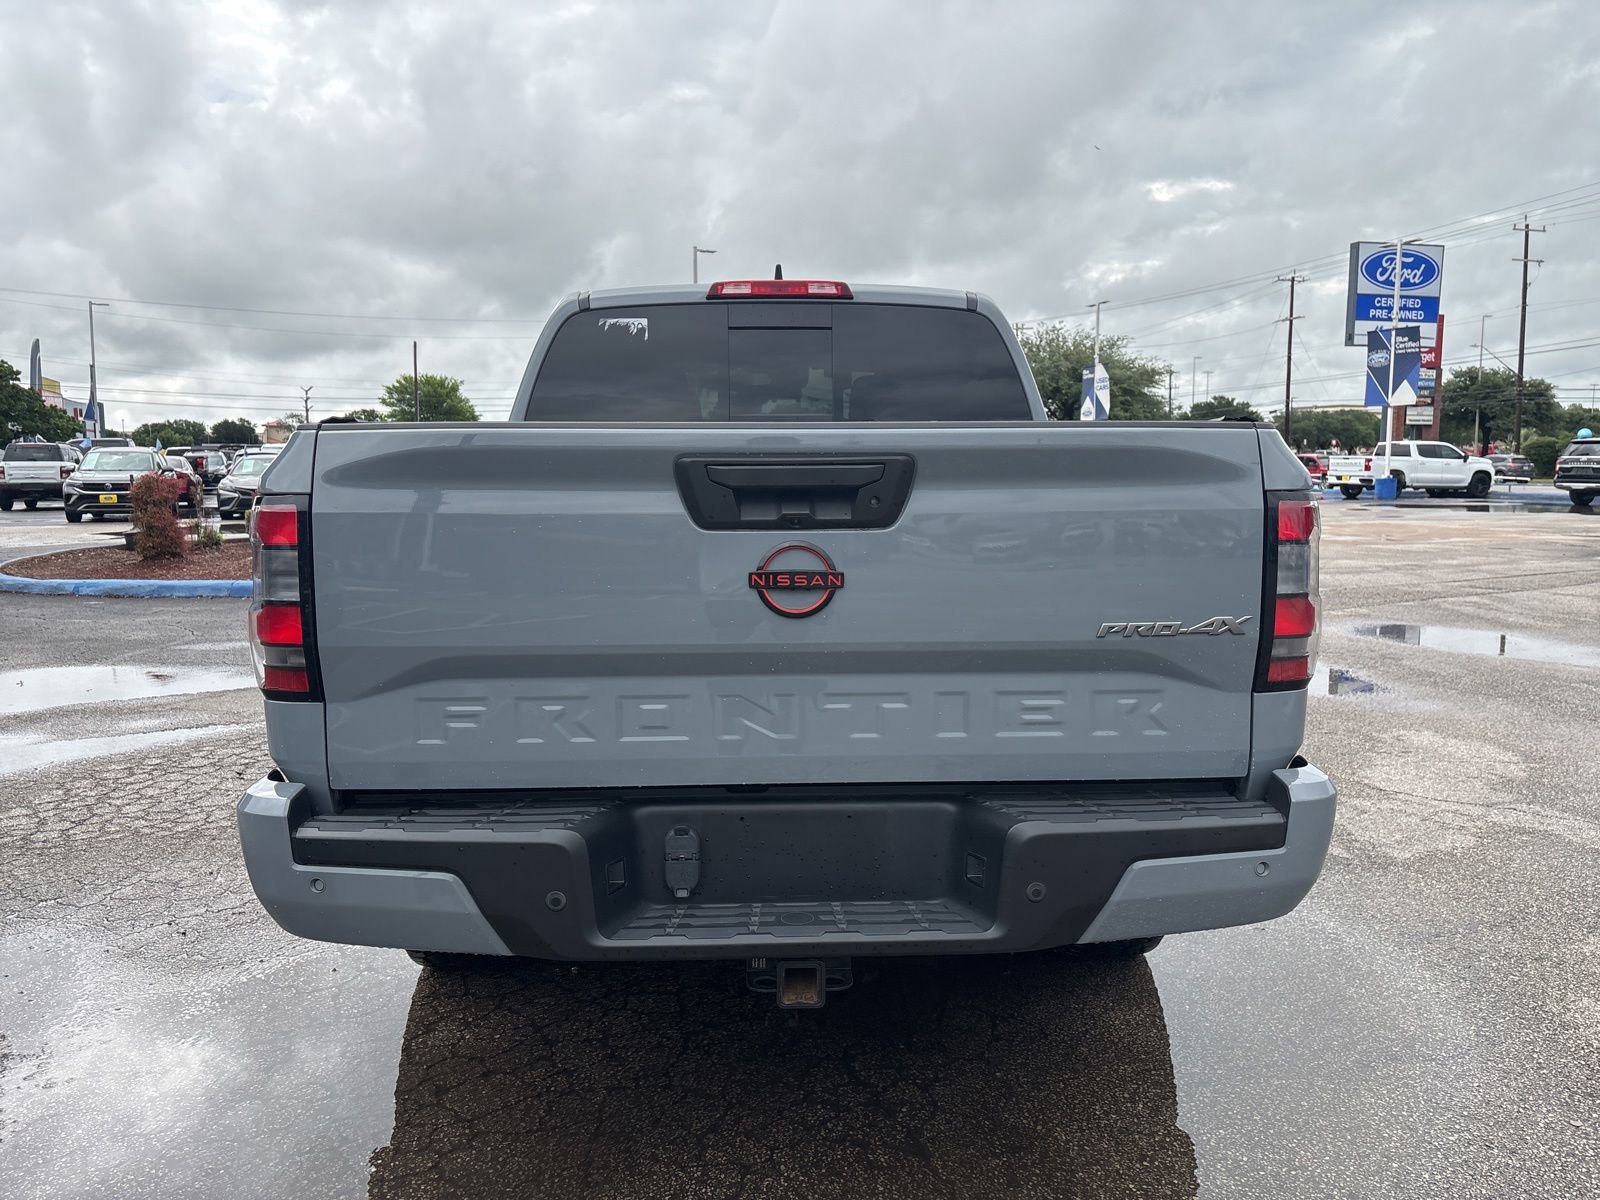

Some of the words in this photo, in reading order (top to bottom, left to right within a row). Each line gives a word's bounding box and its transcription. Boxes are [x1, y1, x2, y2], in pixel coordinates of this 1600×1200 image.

[1374, 297, 1421, 308] CERIFIED
[1395, 341, 1420, 349] Certified
[751, 574, 842, 586] NISSAN
[1096, 615, 1253, 638] PRO-4X
[413, 688, 1168, 745] FRONTIER
